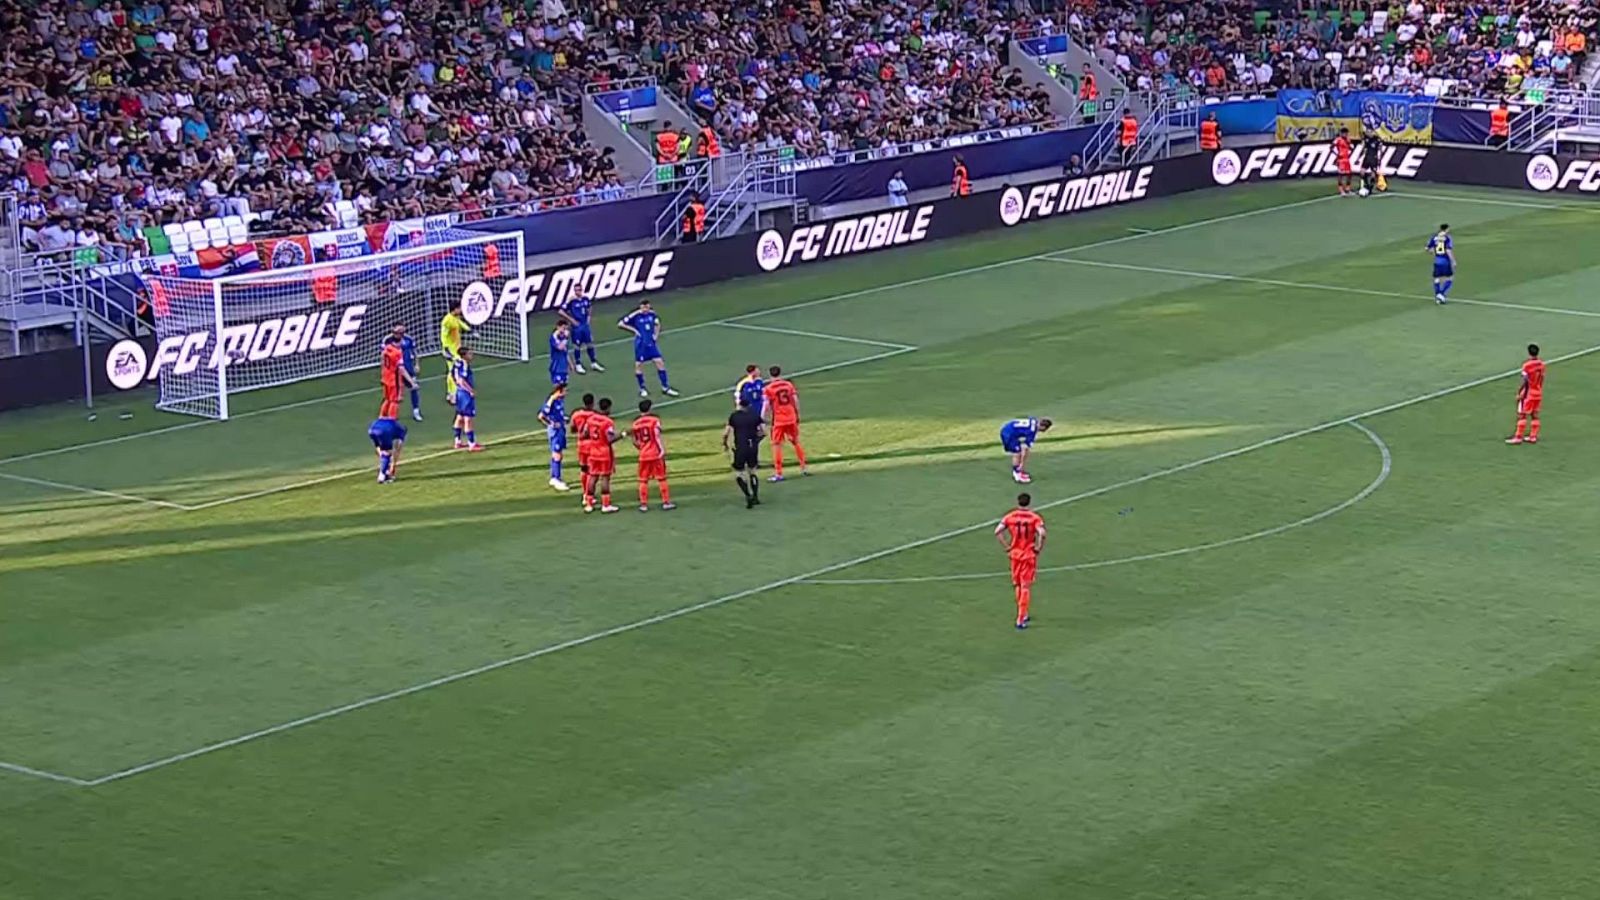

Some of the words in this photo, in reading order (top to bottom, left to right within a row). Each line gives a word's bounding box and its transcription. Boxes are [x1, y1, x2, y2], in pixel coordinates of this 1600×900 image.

[1239, 146, 1290, 179] FC
[1022, 183, 1060, 219] FC
[1057, 166, 1153, 212] MOBILE
[783, 224, 827, 263] FC
[823, 205, 934, 256] MOBILE
[493, 274, 545, 317] FC
[542, 251, 674, 309] MOBILE
[115, 350, 138, 368] EA
[147, 331, 210, 380] FC
[208, 304, 368, 370] MOBILE
[775, 389, 790, 406] 13
[1016, 520, 1029, 540] 11
